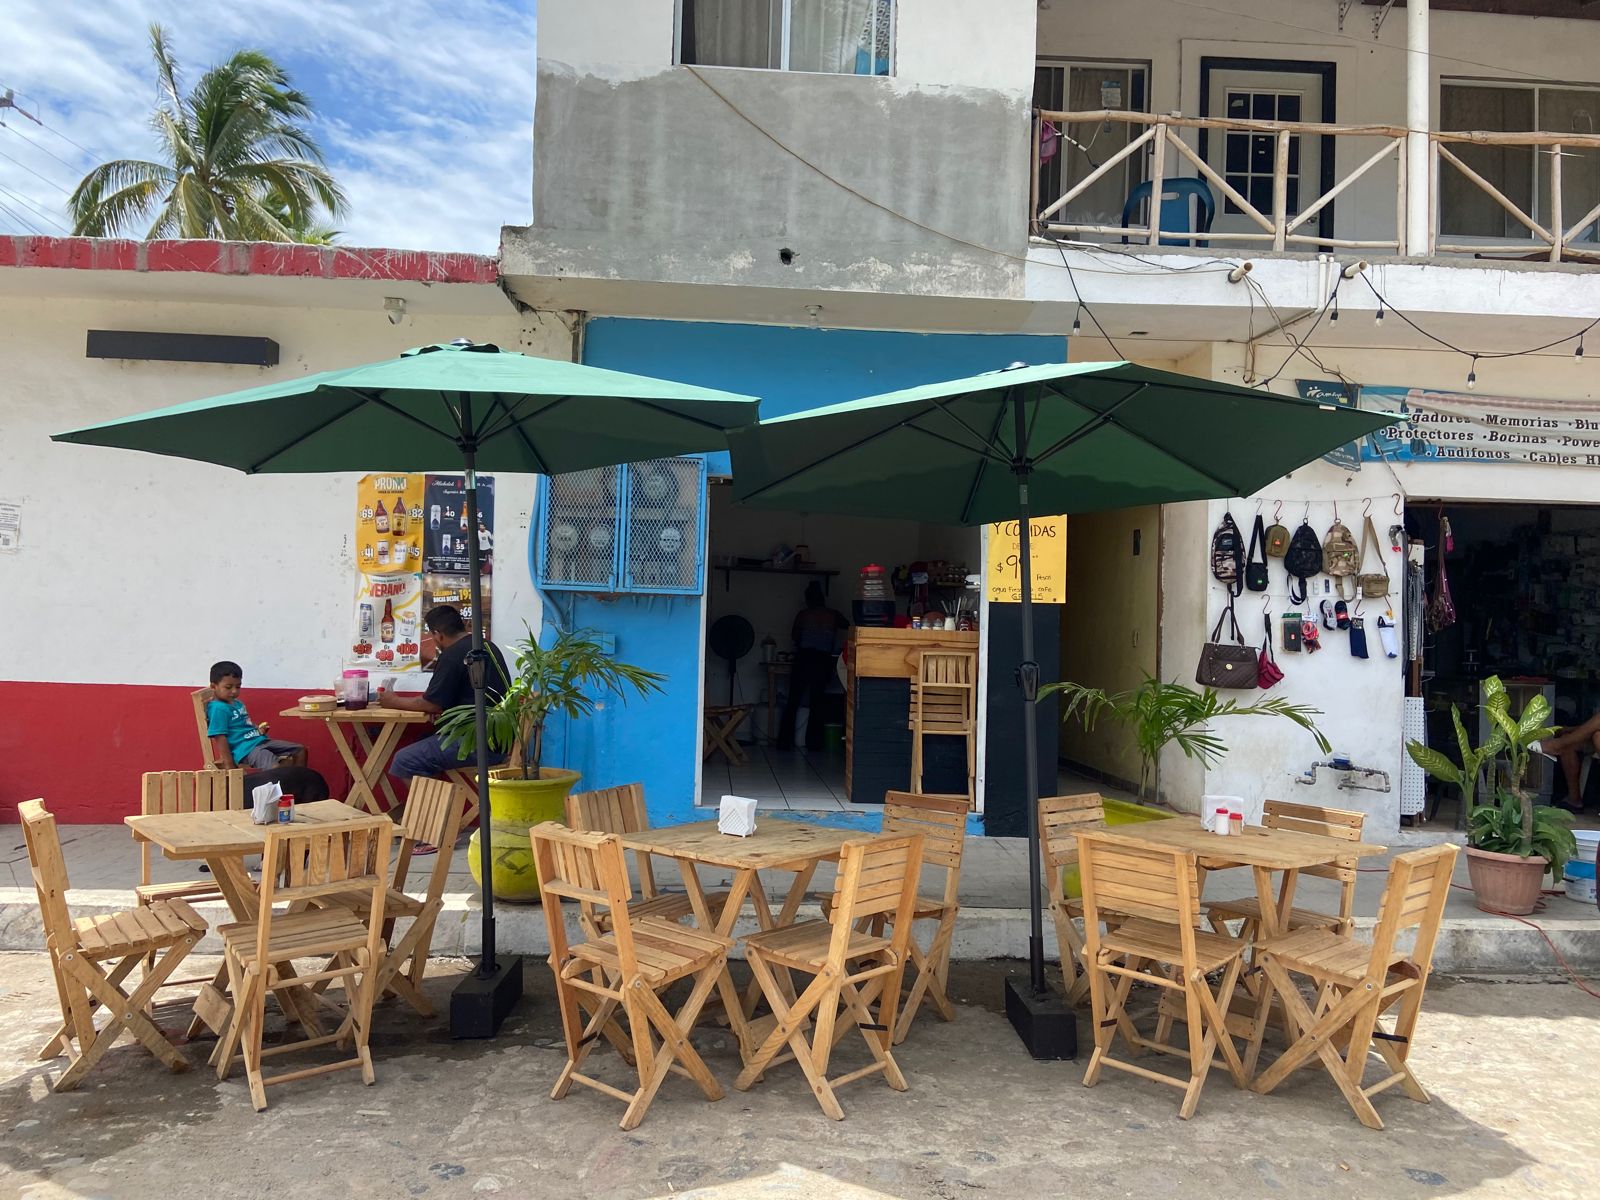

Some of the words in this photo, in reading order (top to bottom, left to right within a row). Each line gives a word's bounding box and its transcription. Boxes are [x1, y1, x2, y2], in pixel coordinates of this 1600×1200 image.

[1485, 413, 1559, 428] Memorias
[1387, 427, 1474, 441] Protectores
[1488, 430, 1547, 444] Bocinas
[1436, 445, 1510, 459] Audifonos
[1529, 451, 1577, 464] Cables
[374, 477, 407, 490] PROMO
[993, 521, 1002, 535] Y
[1005, 522, 1057, 538] COIDAS
